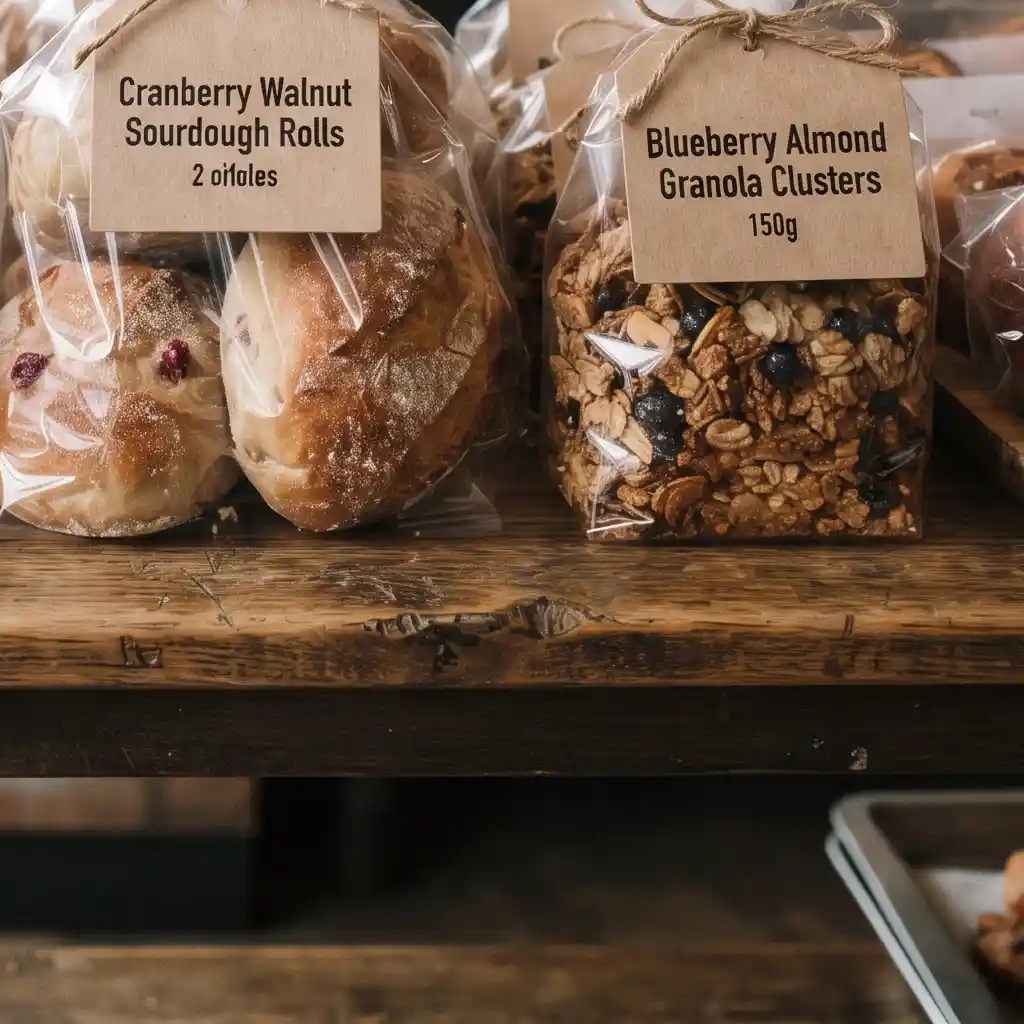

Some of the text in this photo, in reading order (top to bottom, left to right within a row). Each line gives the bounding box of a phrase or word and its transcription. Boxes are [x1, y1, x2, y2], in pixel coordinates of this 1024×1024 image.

[119, 76, 352, 114] Cranberry Walnut
[125, 117, 344, 155] Sourdough Rolls
[647, 122, 887, 164] Blueberry Almond
[192, 163, 204, 186] 2
[660, 165, 882, 199] Granola Clusters
[749, 212, 797, 242] 150g
